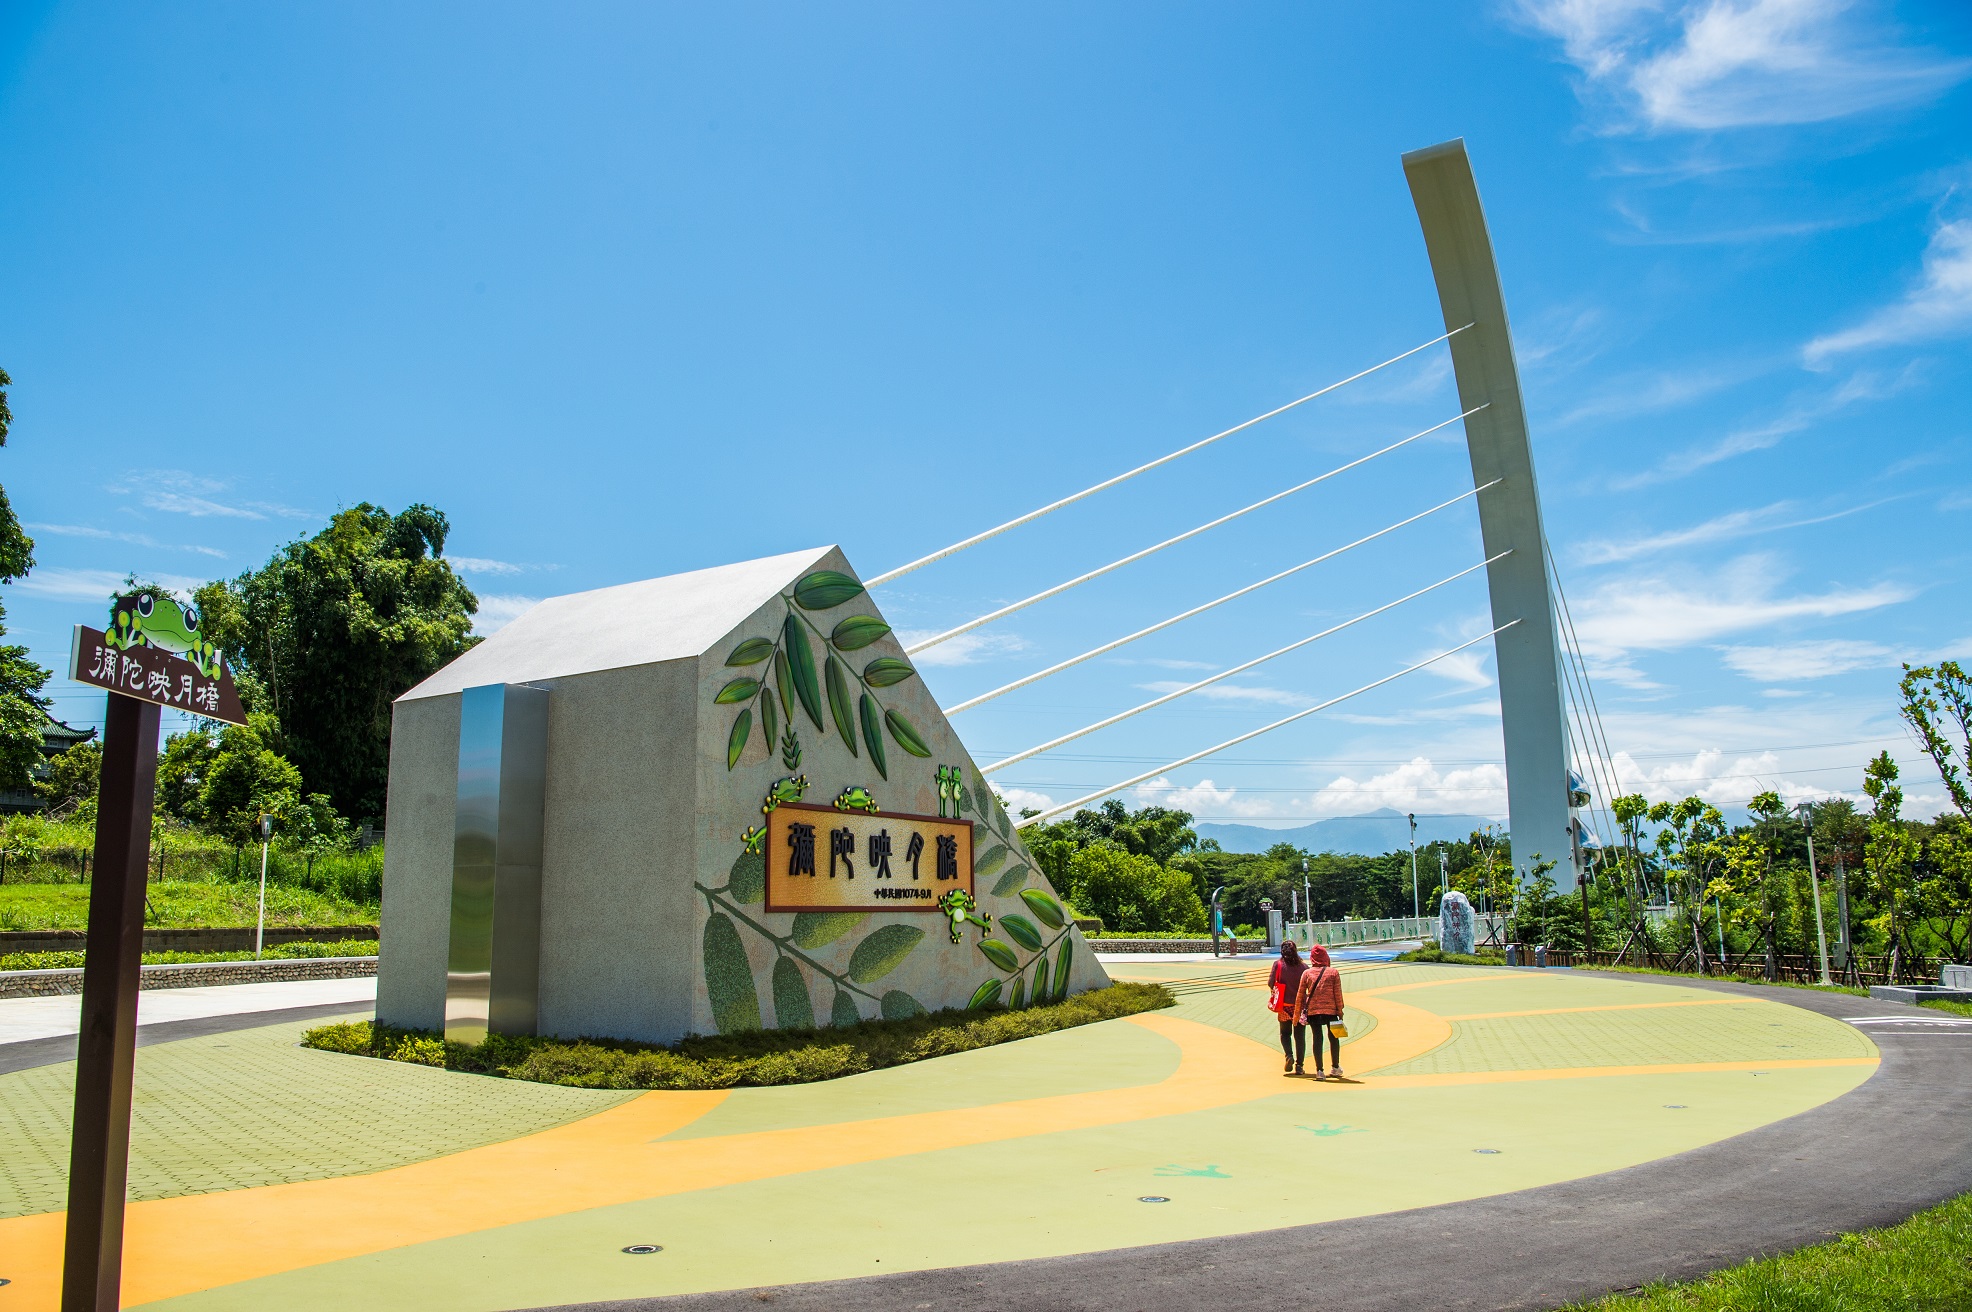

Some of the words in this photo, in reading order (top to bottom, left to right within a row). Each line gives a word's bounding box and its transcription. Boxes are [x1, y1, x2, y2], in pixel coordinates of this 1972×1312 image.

[88, 645, 220, 712] 彌陀映月橋
